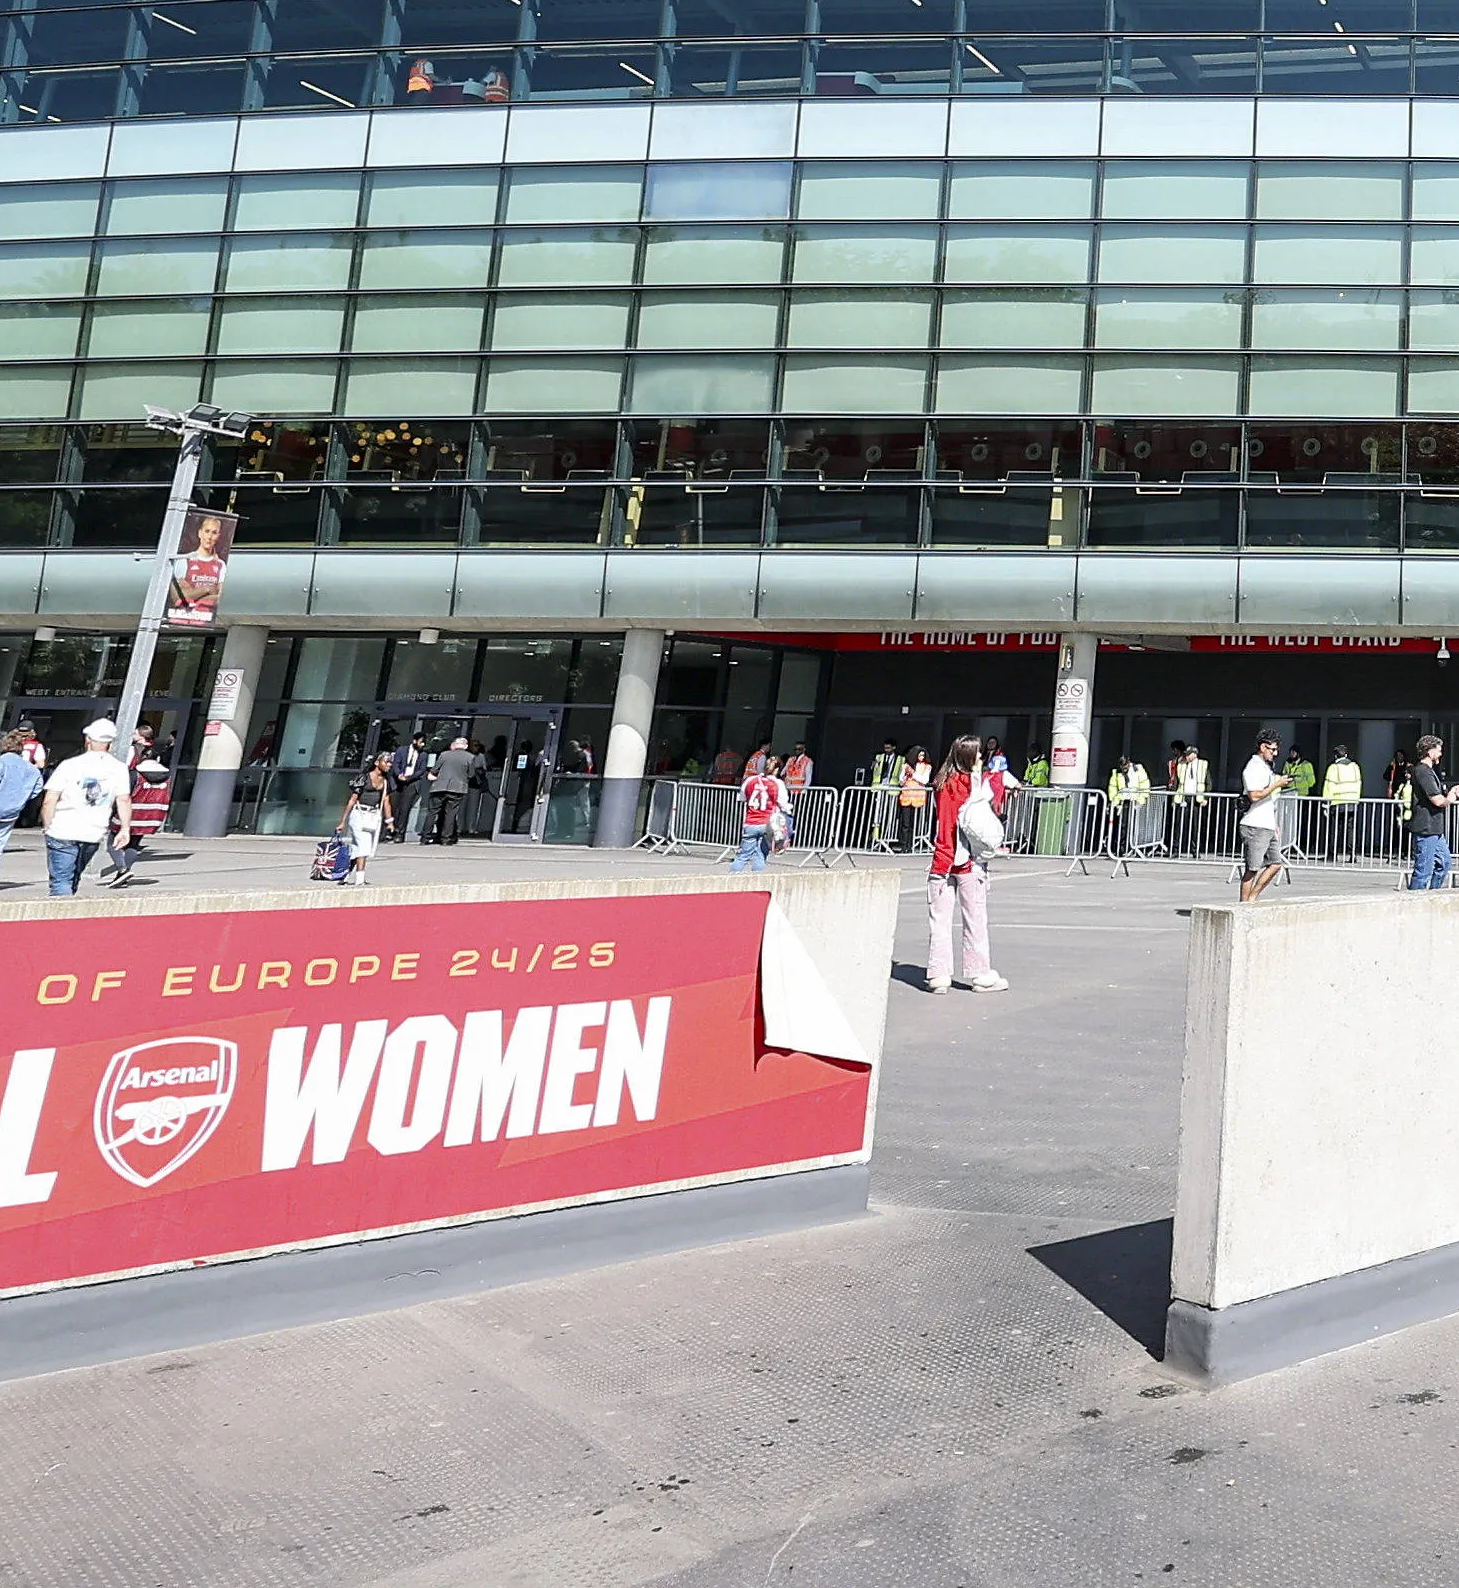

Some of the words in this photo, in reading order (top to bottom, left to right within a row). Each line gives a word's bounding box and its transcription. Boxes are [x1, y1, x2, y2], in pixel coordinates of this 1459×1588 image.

[488, 693, 544, 703] DIRECTORS
[36, 970, 127, 1007] OF
[162, 952, 420, 997] EUROPE
[449, 941, 617, 977] 24/25
[121, 1057, 219, 1089] Arsenal
[260, 996, 671, 1173] WOMEN
